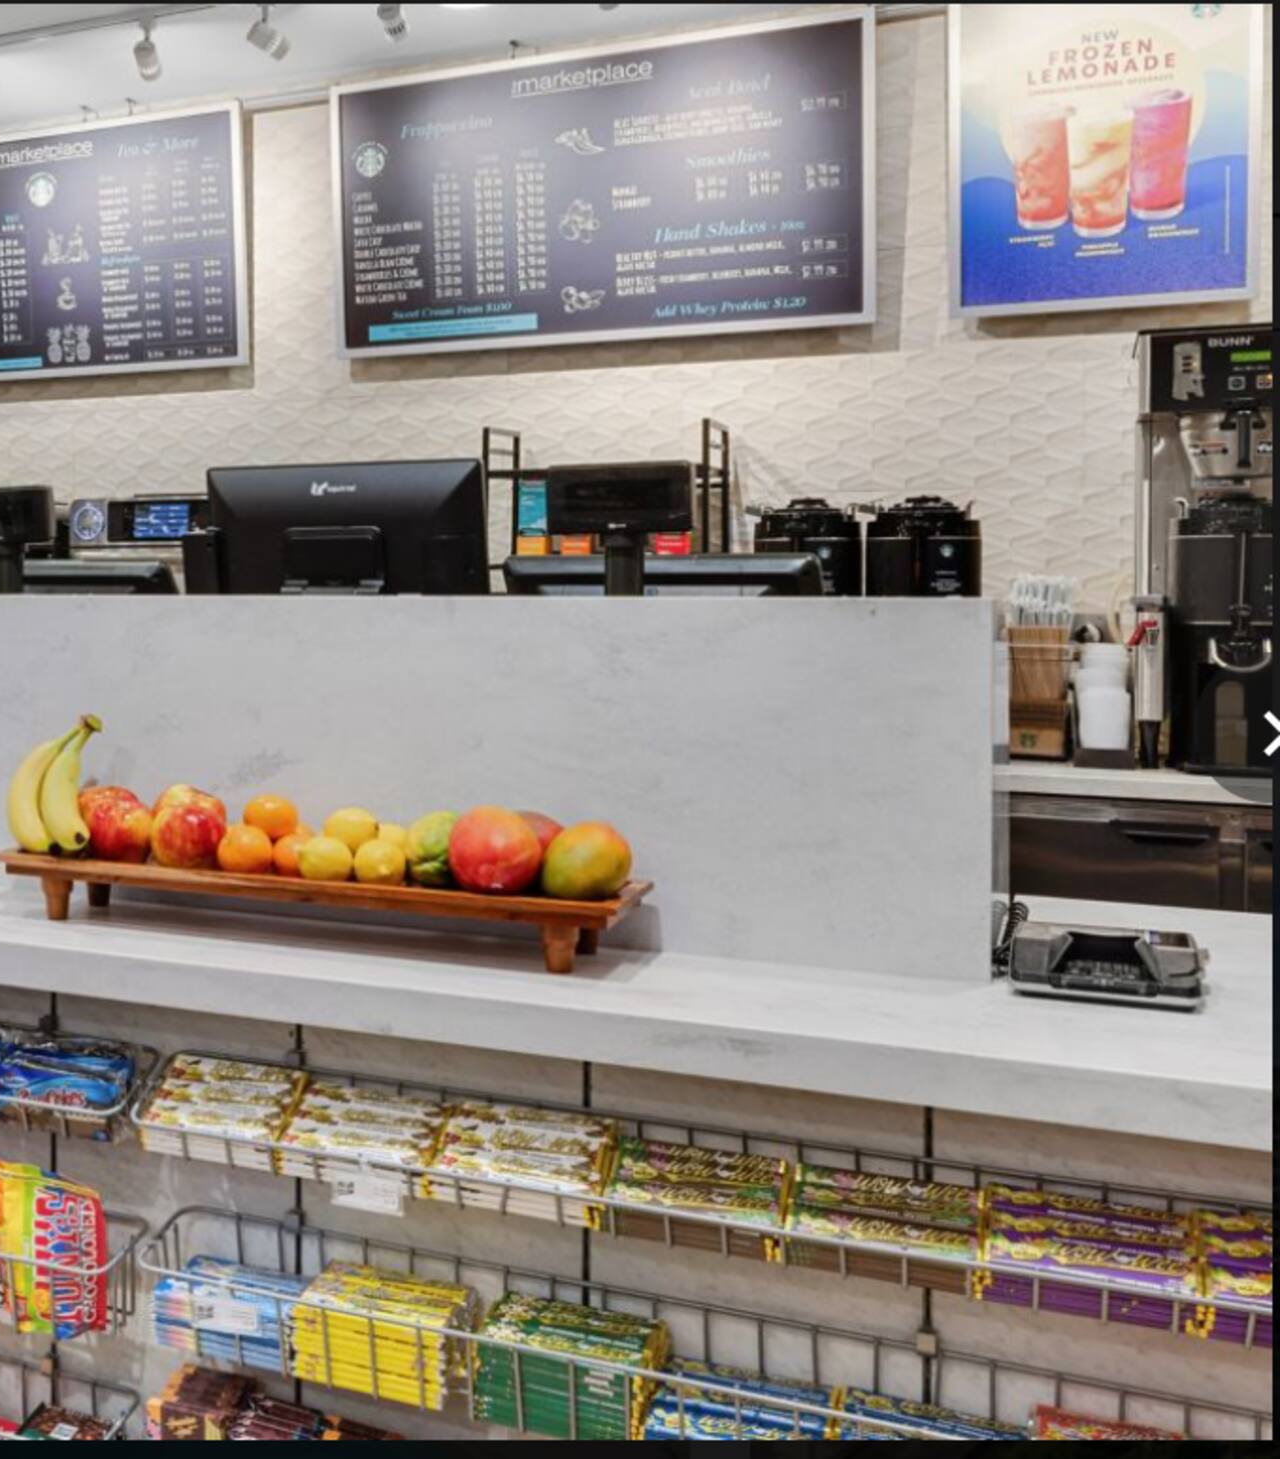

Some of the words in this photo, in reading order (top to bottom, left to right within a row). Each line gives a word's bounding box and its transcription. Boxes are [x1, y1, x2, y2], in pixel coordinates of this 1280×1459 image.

[1081, 29, 1118, 43] NEW
[1048, 38, 1152, 66] FROZEN
[519, 58, 653, 92] marketplace
[1027, 52, 1176, 85] LEMONADE
[687, 147, 770, 168] Smoothies
[654, 223, 702, 244] Hand
[705, 219, 768, 237] Shakes
[392, 309, 419, 320] Sweet
[421, 307, 455, 318] Cream
[457, 304, 484, 316] Foam
[654, 302, 677, 319] Add
[680, 301, 717, 317] Whey
[1207, 336, 1251, 348] BUNN
